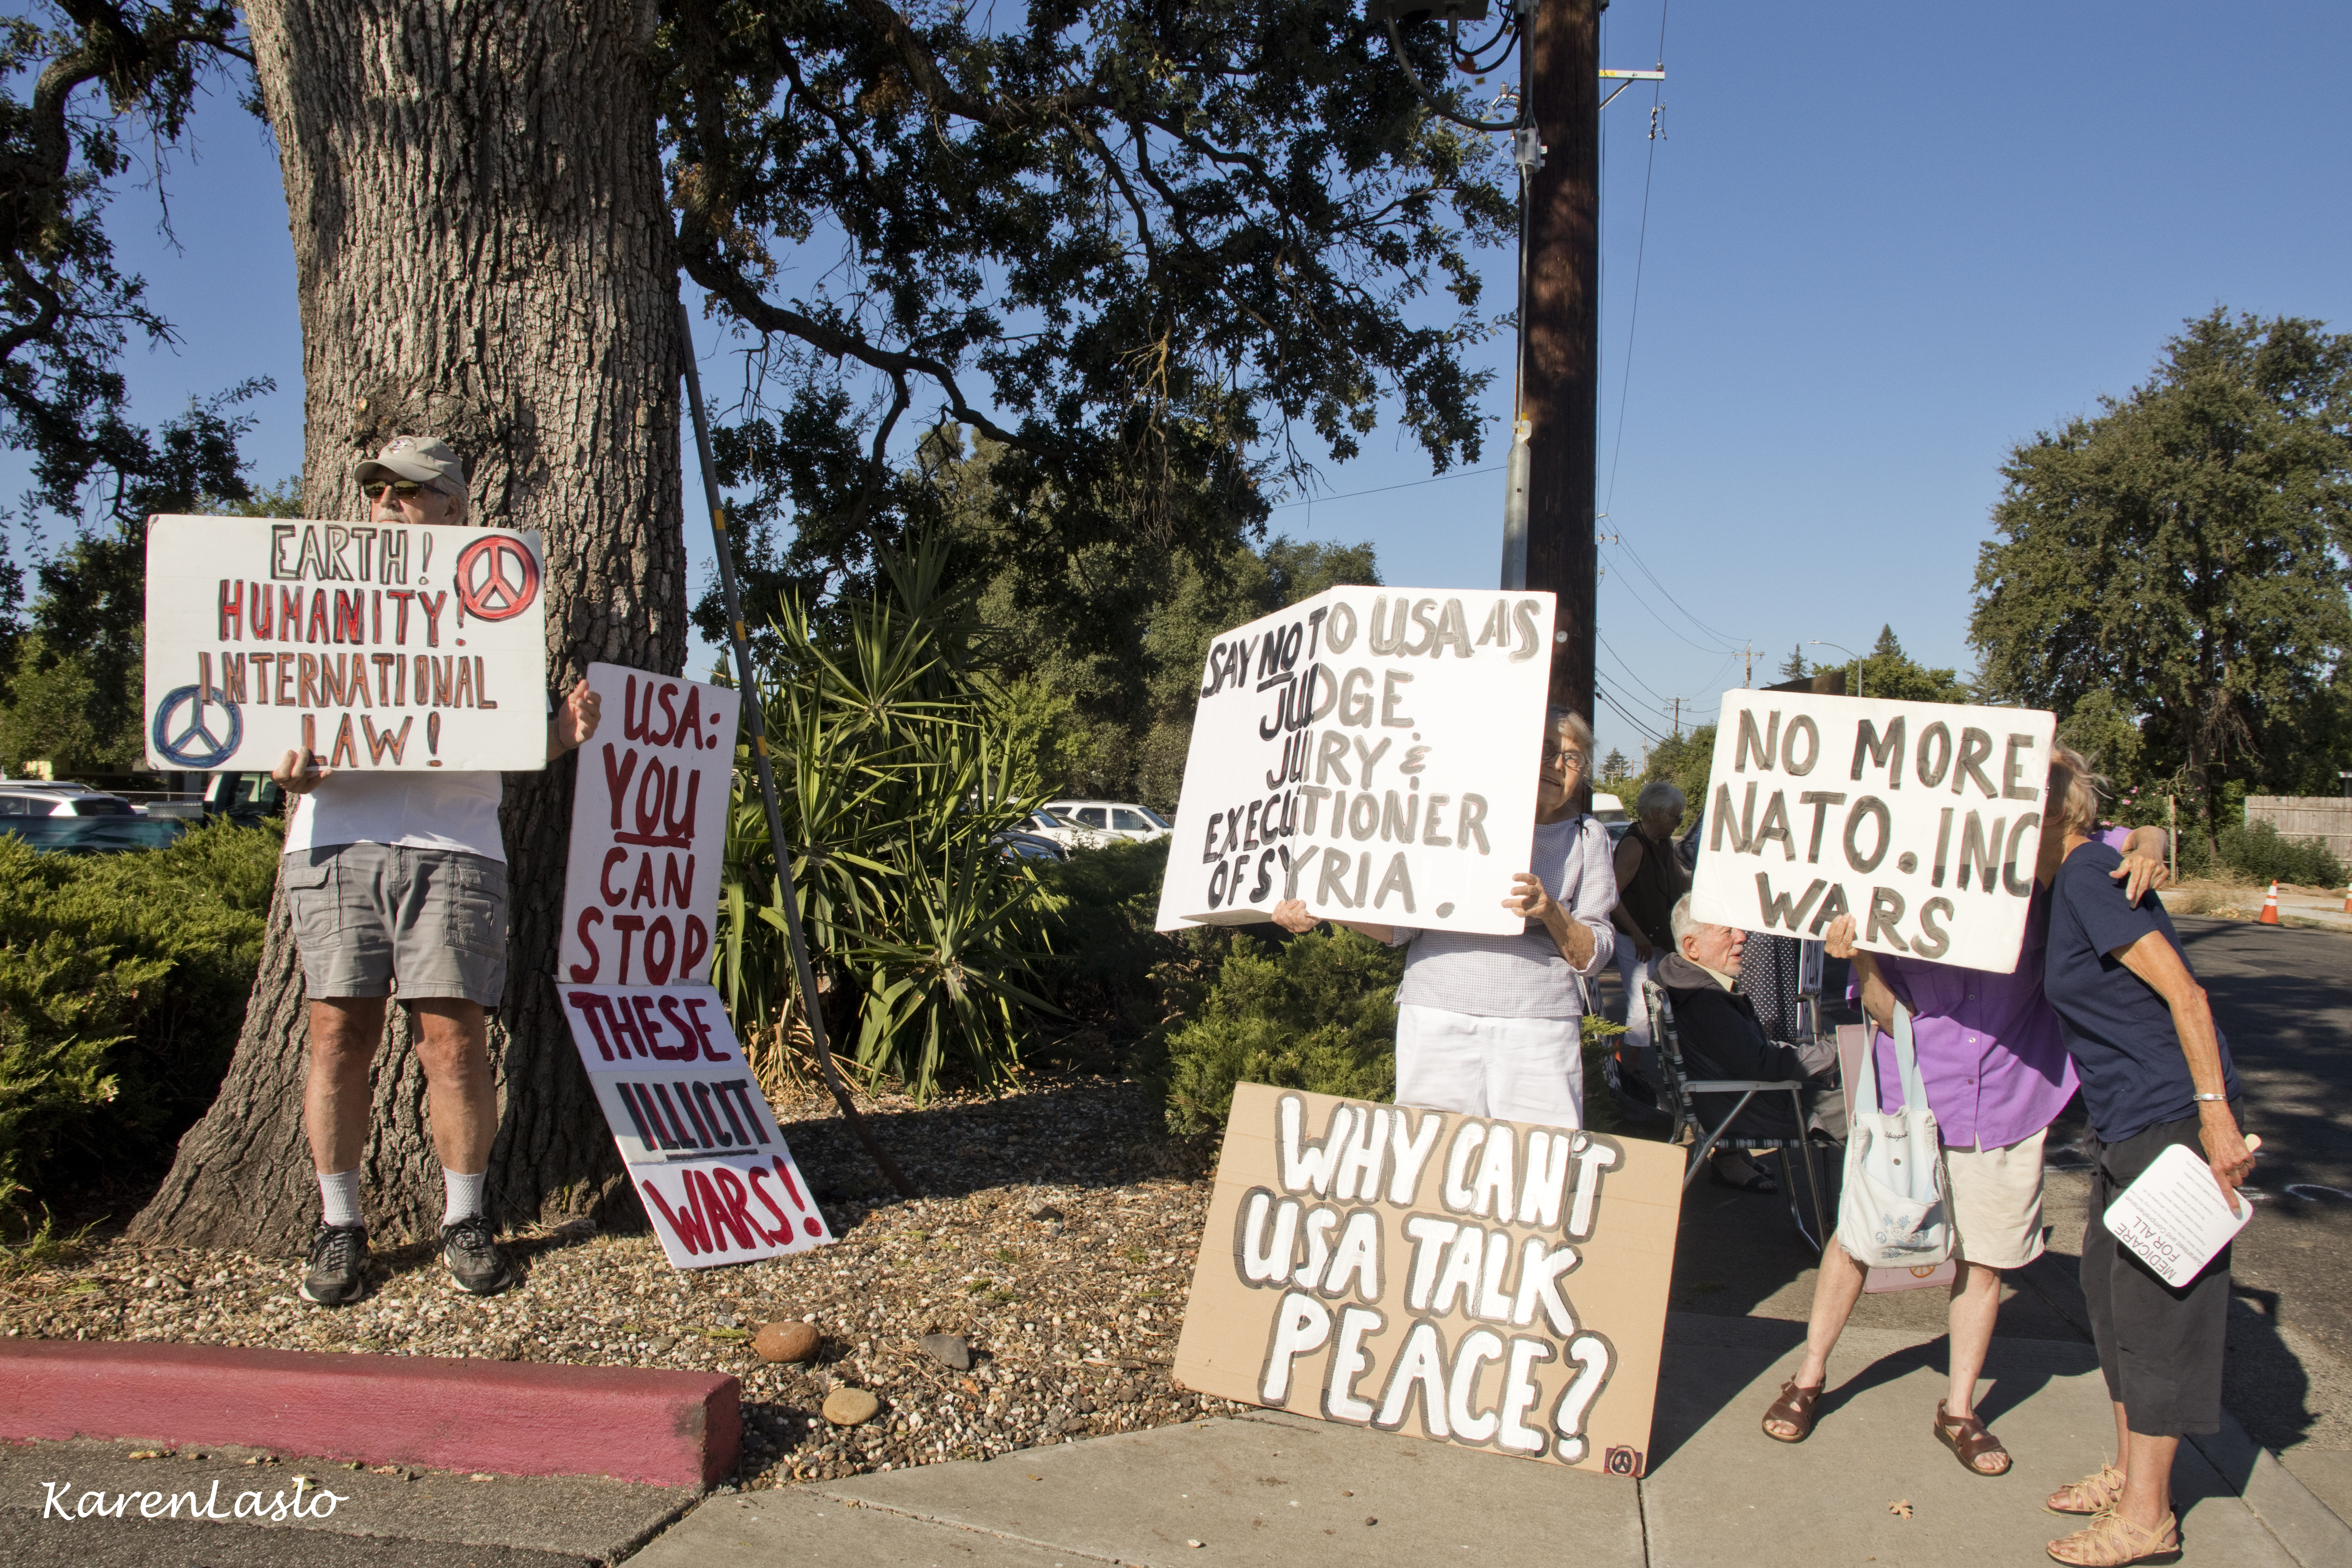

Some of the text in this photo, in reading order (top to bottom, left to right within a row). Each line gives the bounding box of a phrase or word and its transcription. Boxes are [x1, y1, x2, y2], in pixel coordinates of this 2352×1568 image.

[271, 524, 433, 585] EARTH!
[218, 579, 466, 648] HUMANITY!
[1201, 594, 1541, 698] SAY NO TO USA AS
[199, 652, 497, 709] INTERNATIONAL
[625, 674, 721, 750] USA:
[1259, 662, 1415, 741] JUDGE
[301, 711, 443, 768] LAW!
[1267, 730, 1392, 791] JURY
[1735, 708, 2039, 801] NO MORE
[603, 743, 700, 839] YOU
[1203, 784, 1490, 864] EXECUTIONER
[601, 846, 694, 909] CAN
[1208, 844, 1455, 918] OF SYRIA.
[569, 906, 709, 985] STOP
[1755, 871, 1954, 959] WARS
[568, 991, 731, 1062] THESE
[615, 1078, 771, 1152] ILLICIT
[1275, 1090, 1626, 1243] WHY CAN'T
[642, 1155, 824, 1255] WARS!
[2133, 1216, 2180, 1262] FOR ALL
[2165, 1232, 2177, 1242] and
[1233, 1185, 1583, 1337] USA TALK
[2114, 1223, 2176, 1279] MEDICARE
[2175, 1241, 2203, 1267] Guaranteed
[1258, 1287, 1618, 1466] PEACE?
